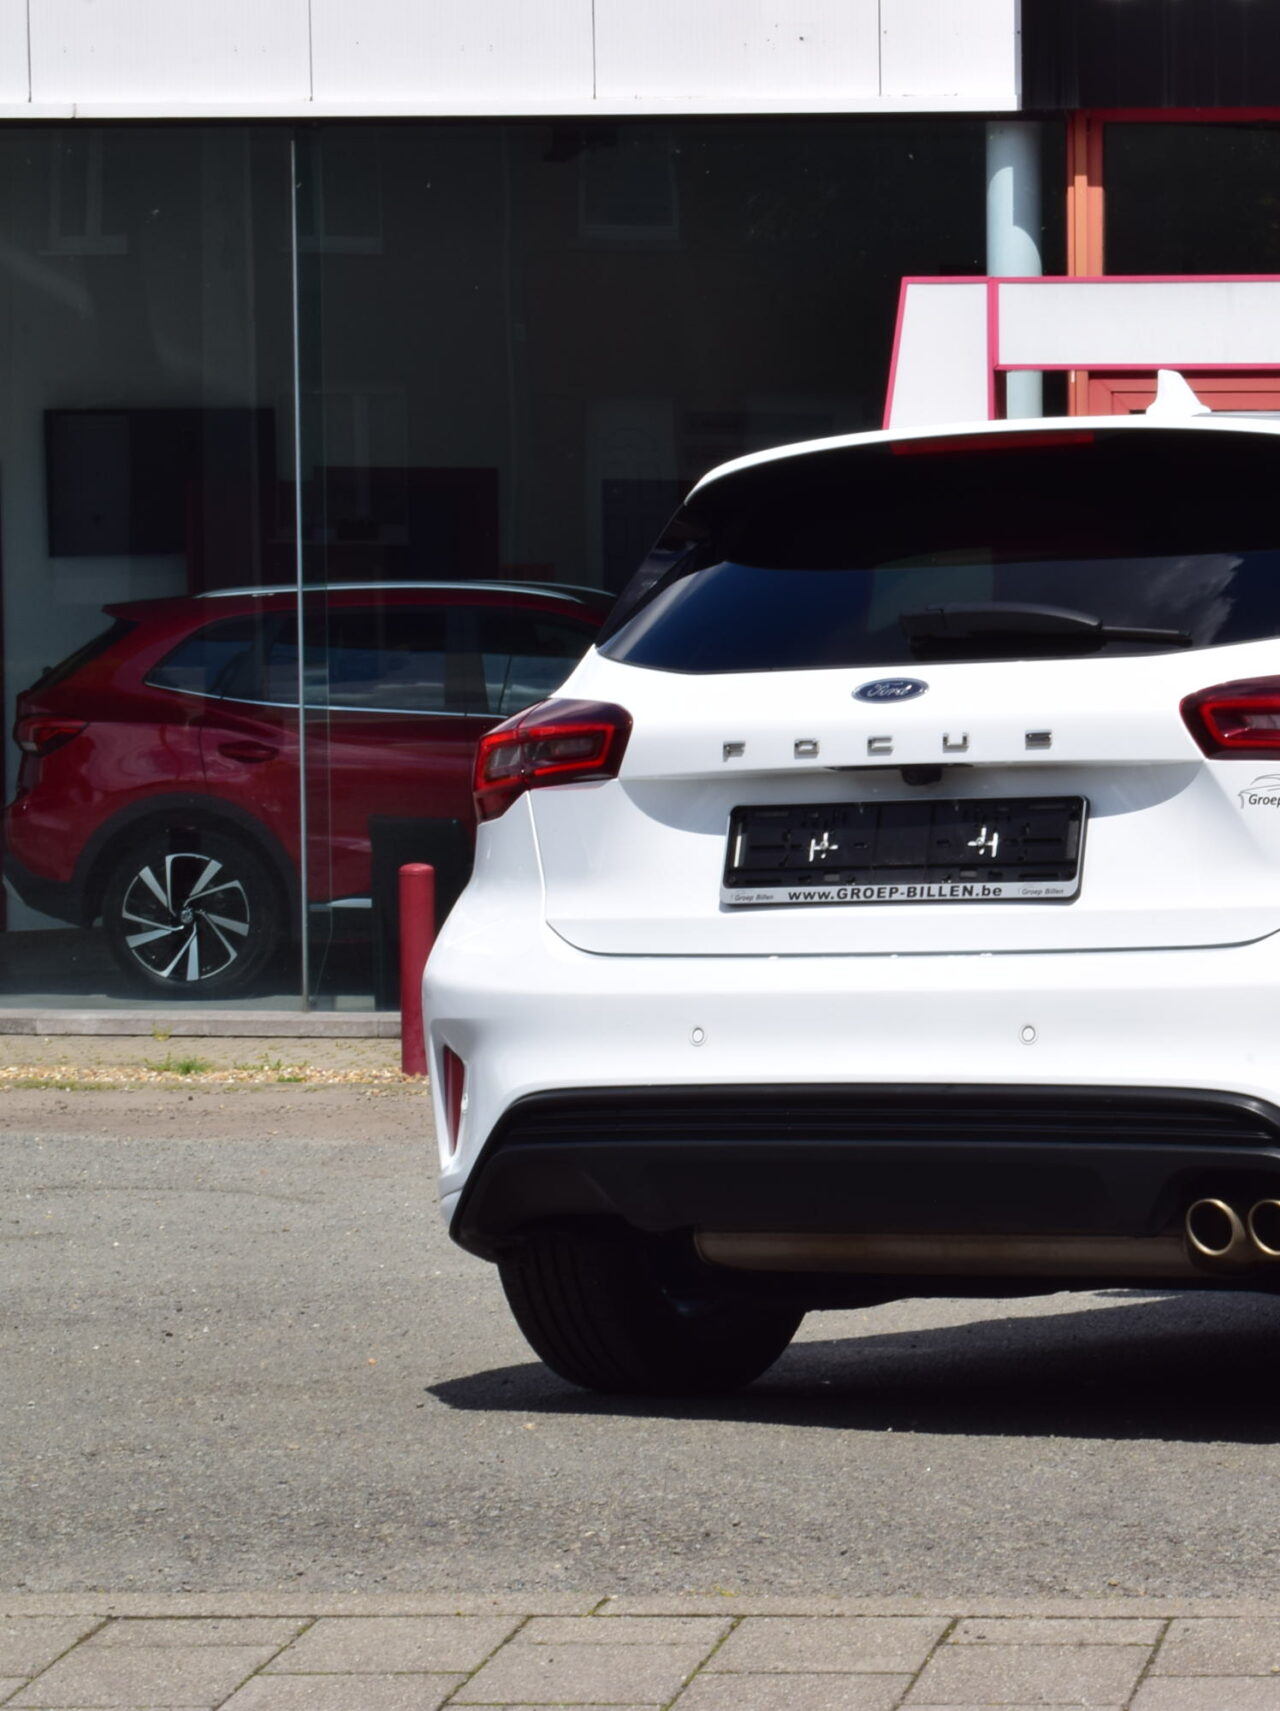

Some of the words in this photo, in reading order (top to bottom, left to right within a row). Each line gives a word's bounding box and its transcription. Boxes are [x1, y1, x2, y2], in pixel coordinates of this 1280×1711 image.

[866, 682, 913, 698] Ford
[723, 731, 1053, 762] FOCUS
[788, 885, 1003, 901] www.GROEP-BILLEN.be
